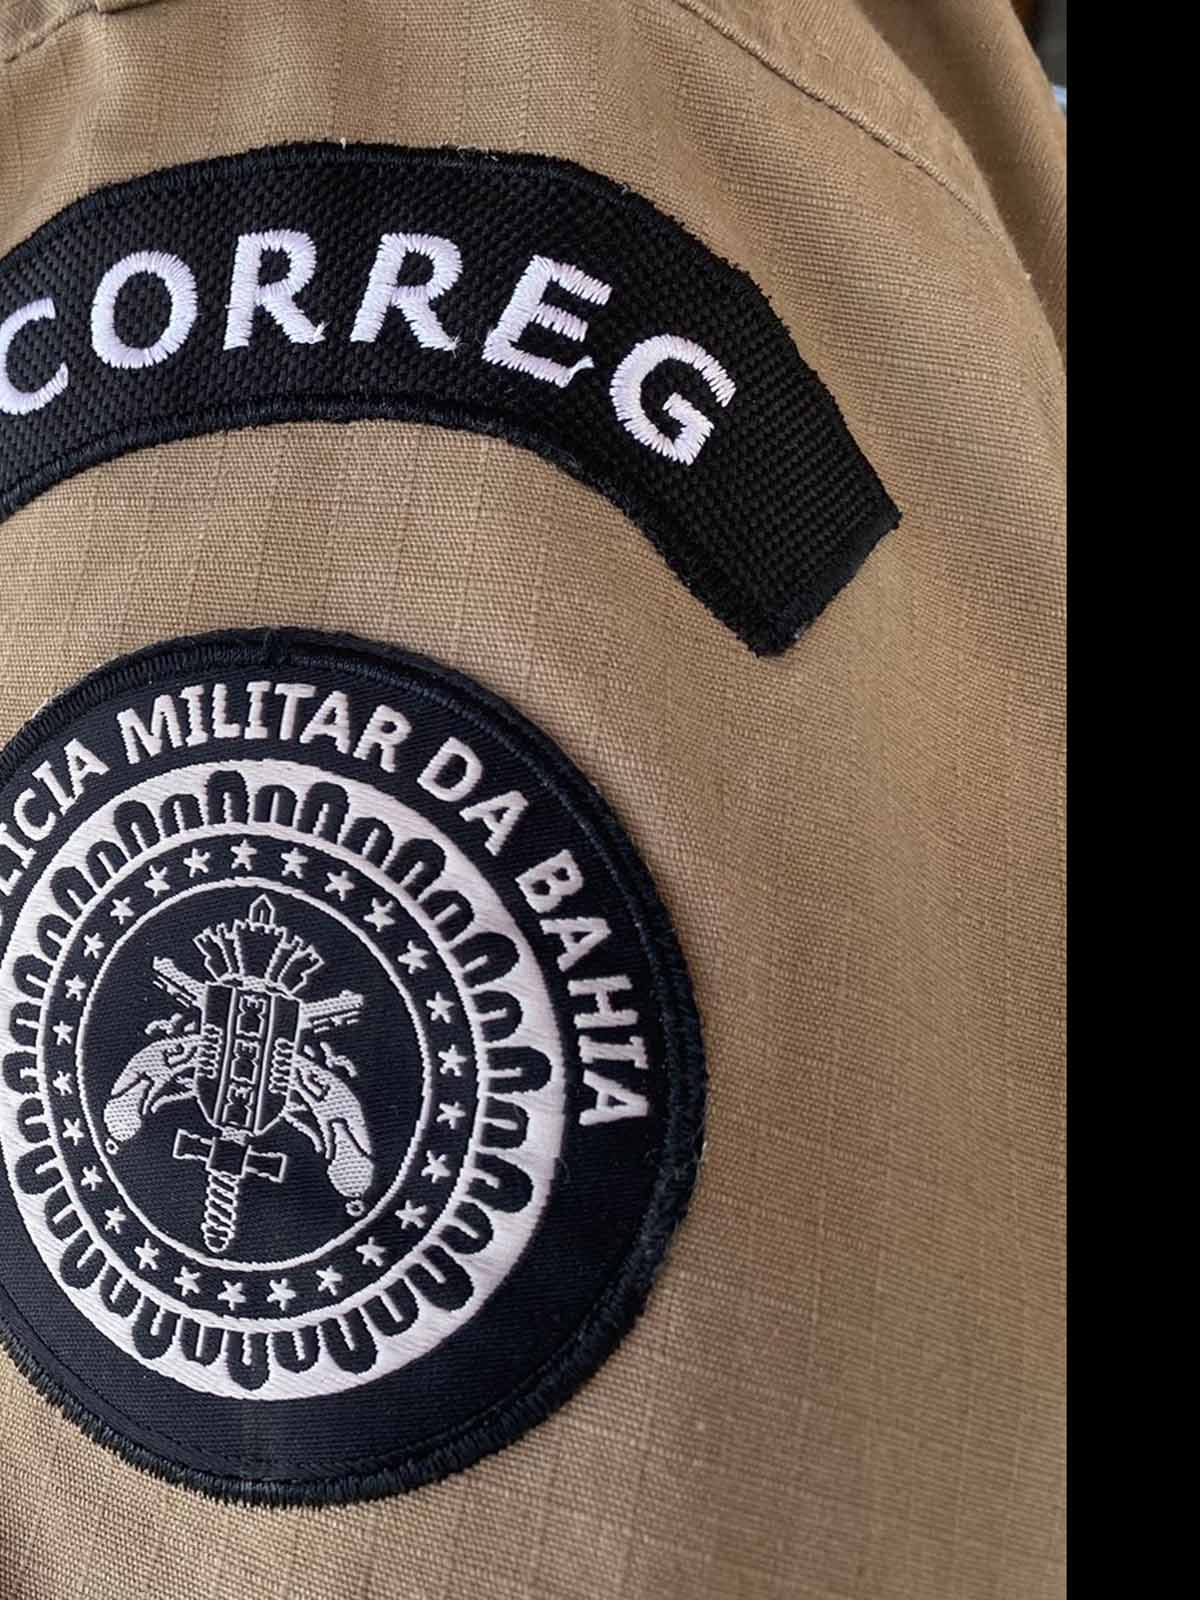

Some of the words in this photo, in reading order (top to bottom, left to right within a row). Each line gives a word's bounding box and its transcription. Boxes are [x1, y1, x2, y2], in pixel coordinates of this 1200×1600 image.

[116, 680, 412, 773] MILITAR
[416, 736, 528, 856] DA
[514, 849, 649, 1127] BAHIA
